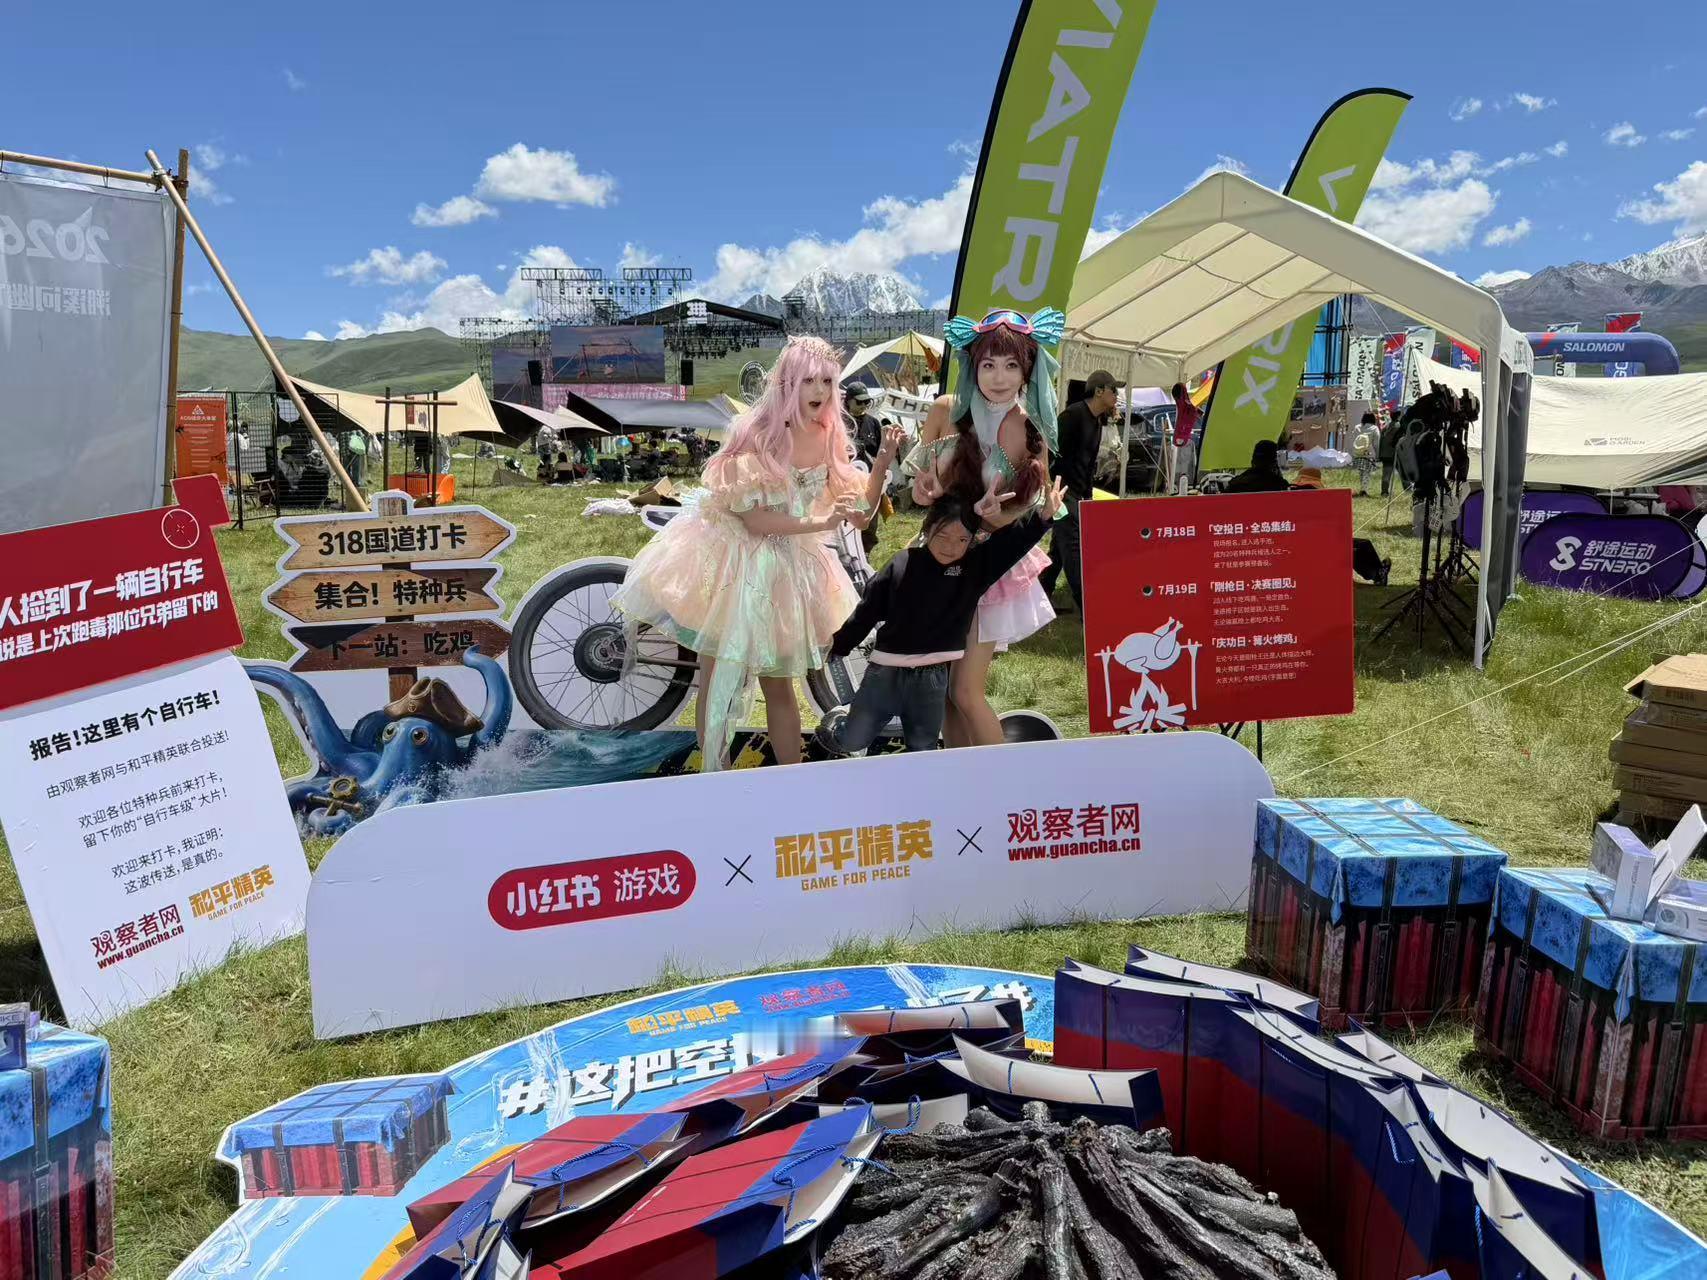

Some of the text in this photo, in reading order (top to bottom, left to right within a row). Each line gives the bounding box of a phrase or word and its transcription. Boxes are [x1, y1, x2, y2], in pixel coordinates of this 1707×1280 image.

[987, 0, 1123, 314] IATR
[1562, 342, 1625, 353] SALOMON
[318, 522, 467, 556] 318国道打卡
[1156, 525, 1196, 538] 7月18日
[1583, 540, 1657, 559] 舒途运动
[1158, 582, 1197, 595] 7月19日
[1007, 802, 1140, 844] 观察者网
[774, 820, 933, 879] 和平精英
[1008, 837, 1141, 862] www.guancha.cn
[188, 864, 275, 918] 和平精英
[506, 863, 681, 917] 小红书 游戏
[801, 865, 911, 891] GAME FOR PEACE
[207, 891, 266, 921] GAME FOR PEACE
[90, 903, 181, 958] 观察者网
[97, 924, 185, 970] www.guancha.cn
[628, 1000, 741, 1034] 和平精英
